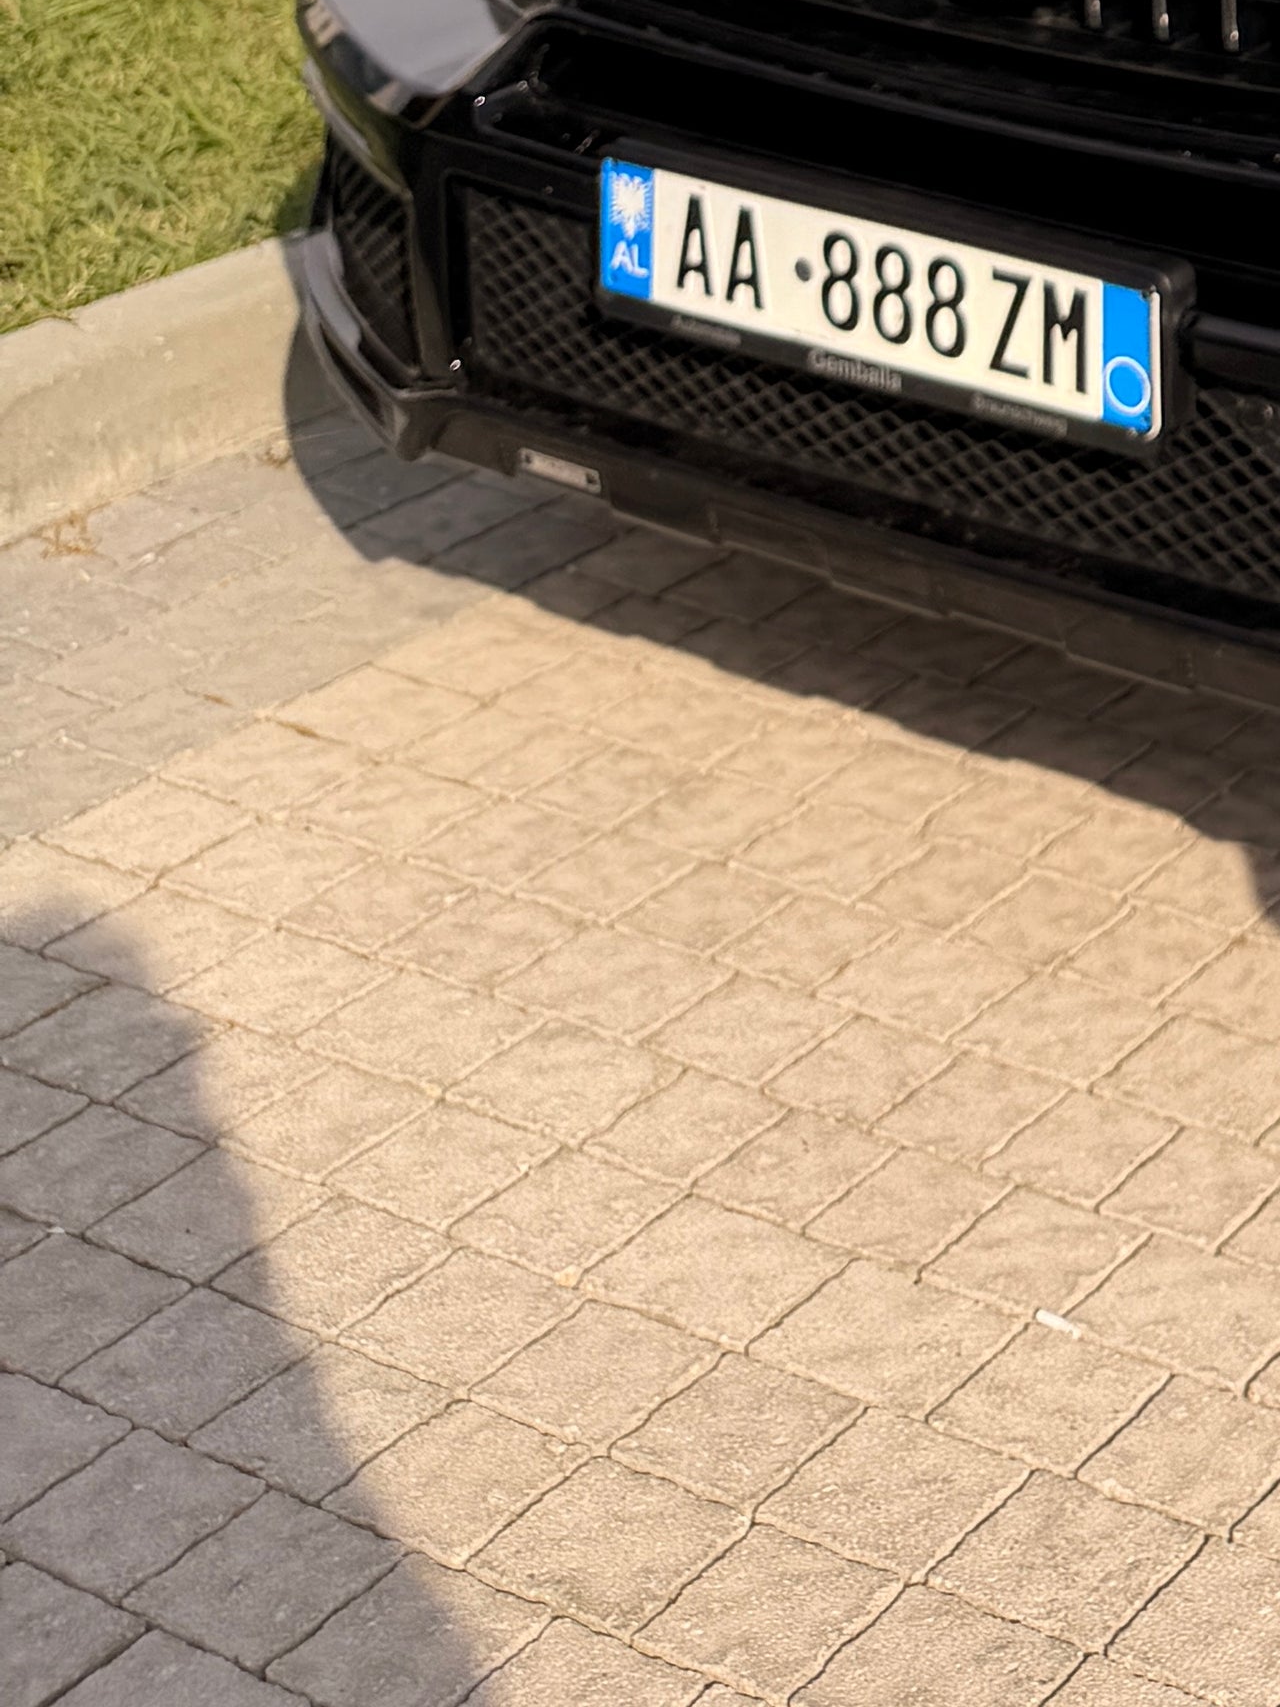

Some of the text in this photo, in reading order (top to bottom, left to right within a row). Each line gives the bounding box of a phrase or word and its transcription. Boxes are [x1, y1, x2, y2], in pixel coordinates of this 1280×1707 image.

[610, 240, 650, 279] AL
[677, 193, 1088, 395] AA 888 ZM
